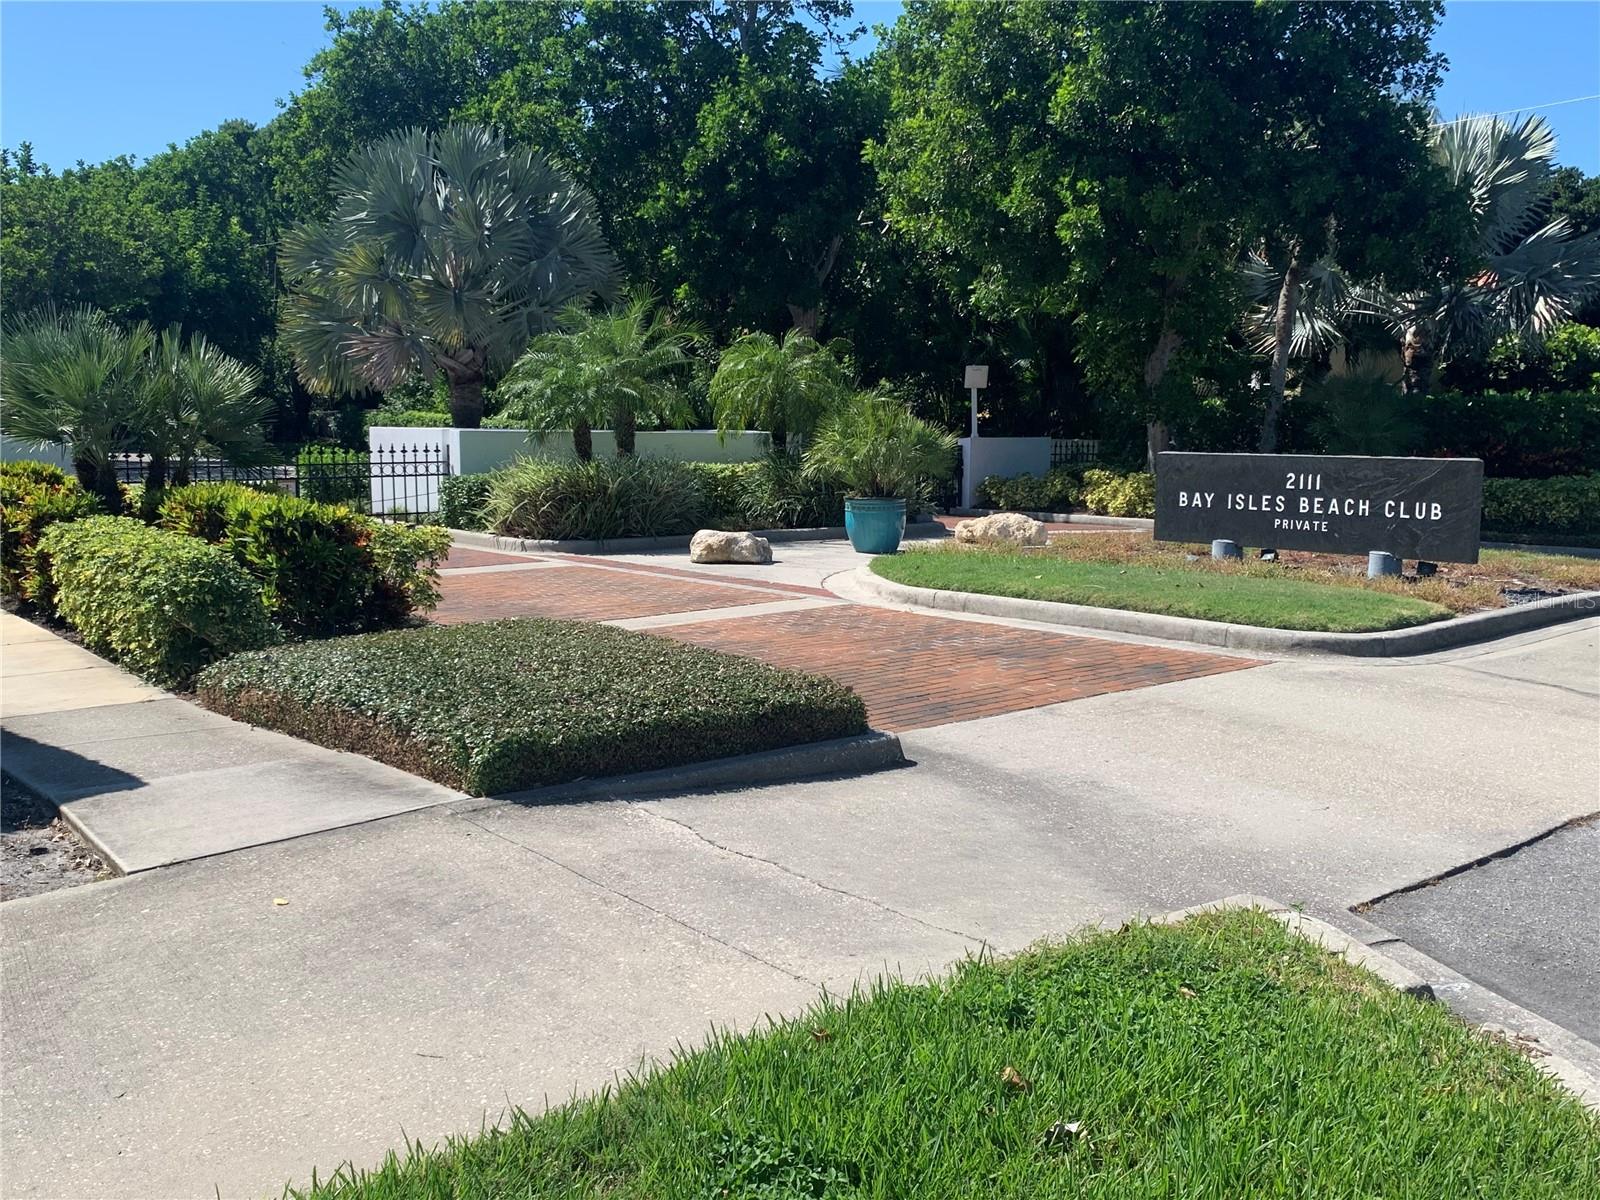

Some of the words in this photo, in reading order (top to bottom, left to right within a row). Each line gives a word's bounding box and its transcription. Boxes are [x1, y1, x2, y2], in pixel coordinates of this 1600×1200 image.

[1286, 472, 1321, 490] 2111
[1179, 492, 1215, 508] BAY
[1227, 493, 1285, 512] ISLES
[1299, 497, 1370, 517] BEACH
[1384, 501, 1443, 521] CLUB
[1274, 518, 1329, 532] PRIVATE
